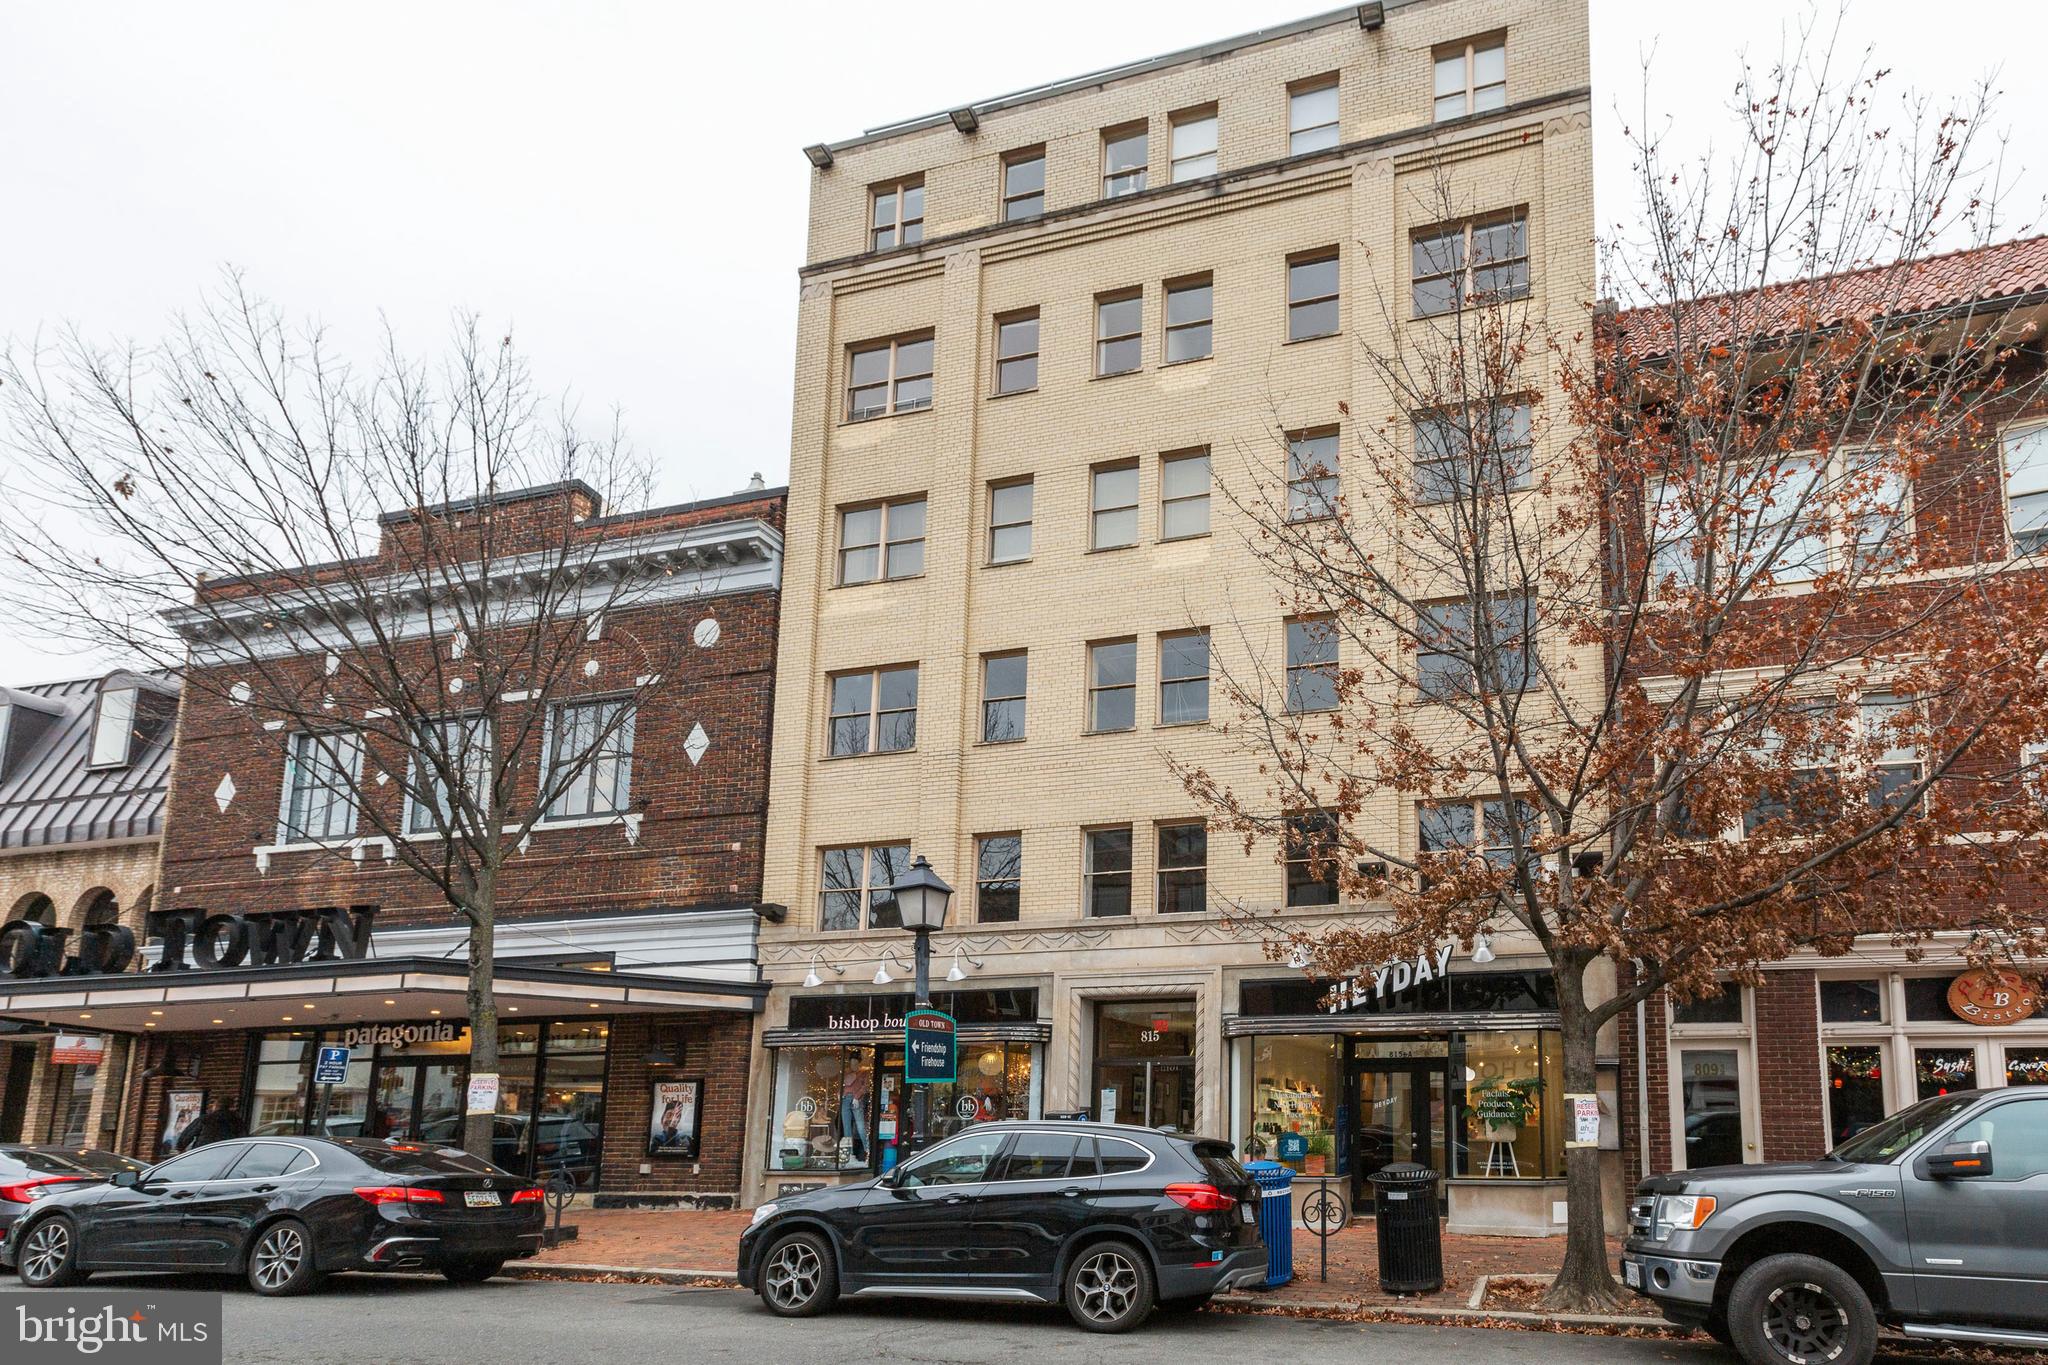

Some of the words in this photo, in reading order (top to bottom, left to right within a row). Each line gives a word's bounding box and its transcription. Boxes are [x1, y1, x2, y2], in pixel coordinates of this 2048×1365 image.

[147, 904, 382, 973] TOWN
[1329, 944, 1454, 1015] HEYDAY
[1960, 997, 2031, 1020] Bistro
[828, 1014, 879, 1032] bishop
[918, 1020, 929, 1029] OLD
[931, 1020, 946, 1029] TOWN
[344, 1020, 454, 1049] patagonia
[1140, 1030, 1160, 1042] 815
[329, 1050, 340, 1060] P
[920, 1041, 947, 1056] Friendship
[921, 1056, 945, 1067] Firehouse
[1933, 1058, 1971, 1074] Sushi
[660, 1083, 694, 1094] Quality
[662, 1095, 674, 1104] for
[677, 1094, 693, 1104] Life
[961, 1099, 975, 1112] bb
[1374, 1096, 1398, 1109] HEYDAY
[1476, 1110, 1516, 1119] Guidance.
